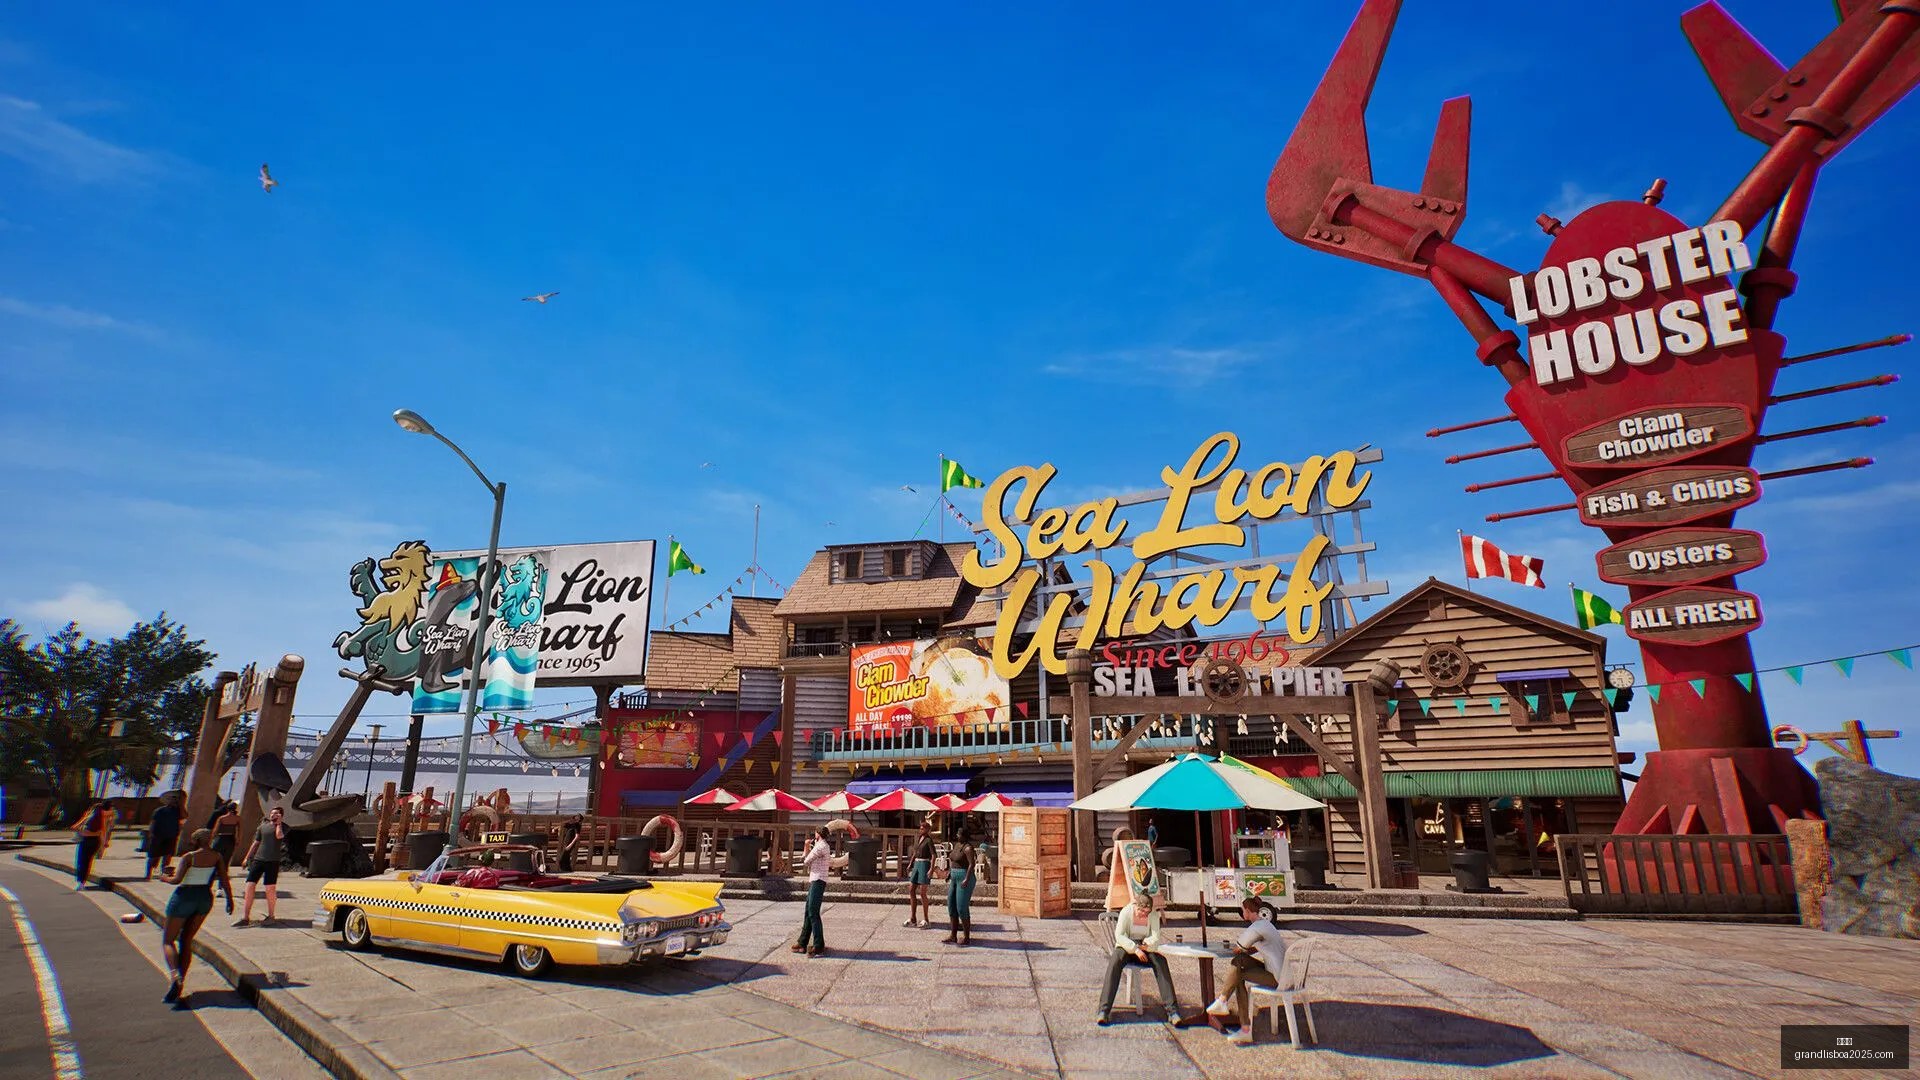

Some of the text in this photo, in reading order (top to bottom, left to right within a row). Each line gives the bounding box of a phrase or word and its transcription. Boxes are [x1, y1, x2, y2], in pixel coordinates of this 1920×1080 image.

[1509, 220, 1751, 325] LOBSTER
[1529, 289, 1748, 386] HOUSE
[1619, 412, 1685, 437] Clam
[1598, 426, 1715, 460] Chowder
[962, 431, 1371, 588] Sea Lion
[1587, 476, 1751, 515] Fish & Chips
[1628, 542, 1733, 571] Oysters
[544, 559, 648, 616] Lion
[992, 534, 1335, 680] Wharf
[1630, 599, 1757, 630] ALL FRESH
[422, 623, 468, 642] Sea Lion
[493, 621, 542, 639] Sea Lion
[495, 633, 537, 652] Wharf
[424, 638, 463, 655] Wharf
[1103, 629, 1290, 669] Since 1965
[565, 653, 601, 674] 1965
[857, 661, 895, 689] Clam
[865, 674, 930, 709] Chowder
[1094, 666, 1345, 697] SEA LIN PIER
[855, 711, 884, 722] ALL DAY
[488, 834, 505, 842] TAXI
